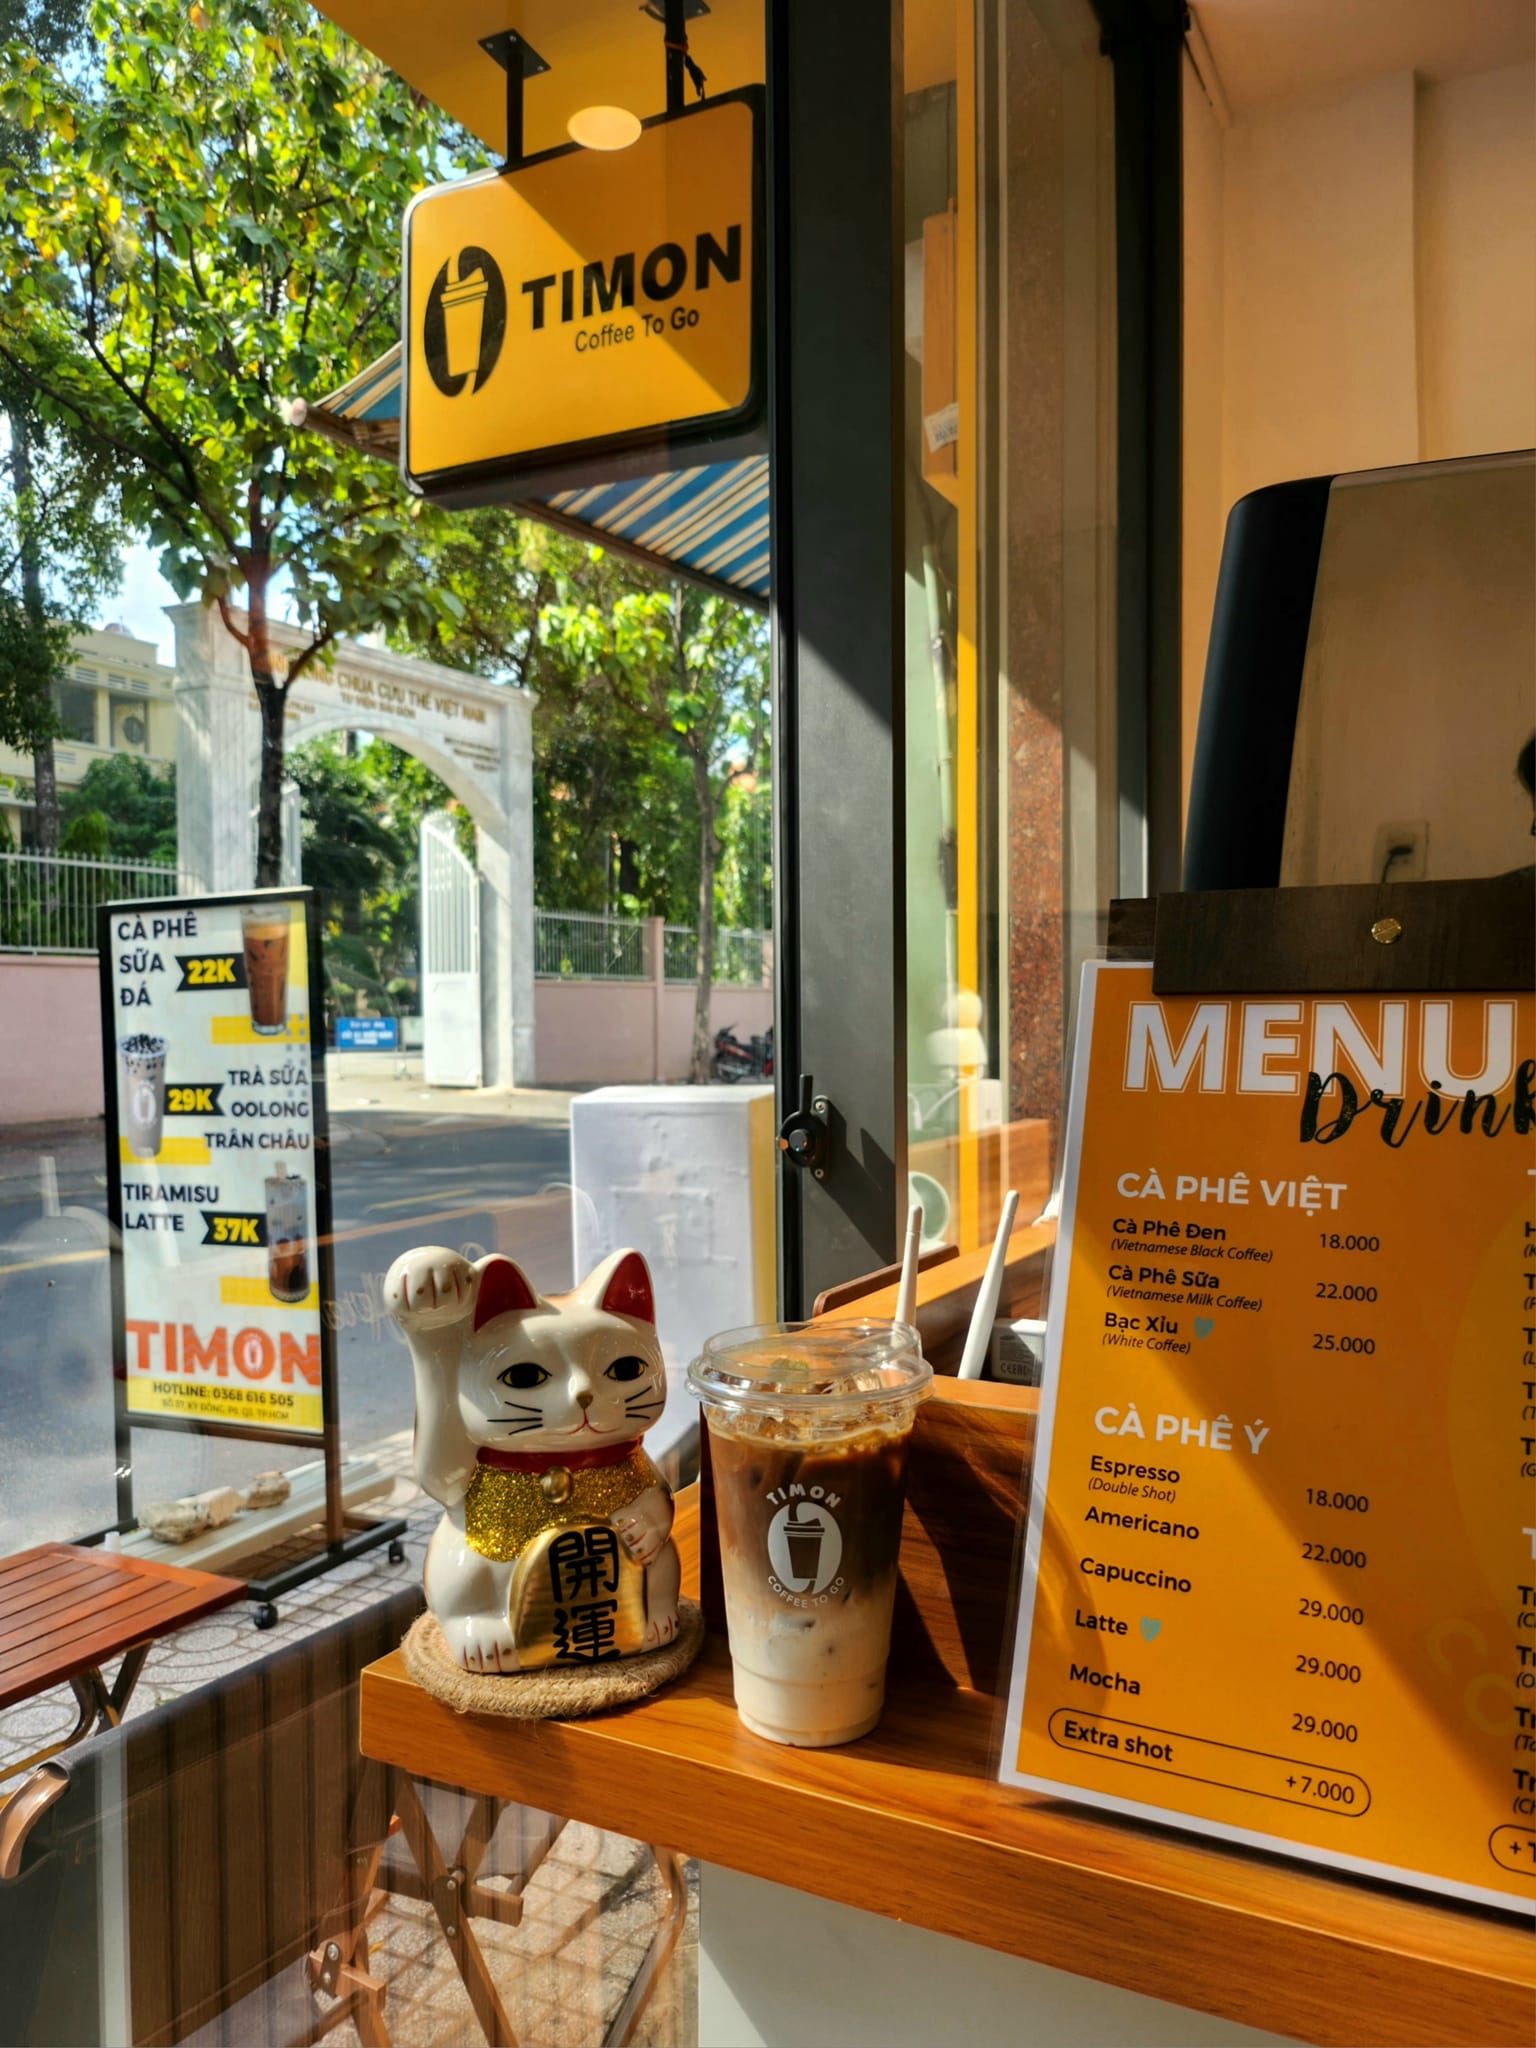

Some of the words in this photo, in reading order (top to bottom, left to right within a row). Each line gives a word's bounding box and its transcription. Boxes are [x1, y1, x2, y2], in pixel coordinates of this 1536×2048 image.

[521, 224, 742, 330] TIMON
[575, 322, 634, 353] Coffee
[641, 313, 665, 338] To
[670, 306, 700, 331] Go
[118, 914, 147, 940] CÀ
[153, 911, 198, 938] PHÊ
[120, 947, 165, 974] SỮA
[186, 957, 236, 985] 22K
[120, 983, 152, 1007] ĐÁ
[1122, 999, 1518, 1101] MENU
[228, 1064, 266, 1087] TRÀ
[270, 1062, 309, 1086] SỮA
[167, 1088, 214, 1113] 29K
[231, 1101, 310, 1118] OOLONG
[204, 1129, 254, 1150] TRÂN
[258, 1129, 310, 1150] CHÂU
[123, 1183, 220, 1204] TIRAMISU
[1117, 1168, 1166, 1200] CÀ
[1175, 1171, 1250, 1205] PHÊ
[1260, 1174, 1348, 1217] VIỆT
[124, 1213, 185, 1232] LATTE
[212, 1217, 260, 1245] 37K
[1112, 1217, 1137, 1235] Cà
[1143, 1219, 1180, 1238] Phê
[1186, 1222, 1226, 1241] Đen
[1110, 1237, 1188, 1256] (Vietnamese
[1190, 1242, 1224, 1259] Black
[1226, 1246, 1273, 1263] Coffee)
[1319, 1232, 1380, 1252] 18.000
[1108, 1264, 1133, 1282] Cà
[1138, 1266, 1177, 1285] Phê
[1182, 1270, 1220, 1290] Sữa
[1106, 1285, 1184, 1304] (Vietnamese
[1186, 1290, 1214, 1307] Milk
[1216, 1293, 1263, 1312] Coffee)
[1315, 1282, 1378, 1303] 22.000
[1104, 1311, 1141, 1334] Bạc
[1145, 1315, 1179, 1335] Xỉu
[125, 1318, 322, 1387] TIMON
[1101, 1332, 1144, 1349] (White
[1146, 1336, 1191, 1355] Coffee)
[1312, 1333, 1376, 1356] 25.000
[246, 1390, 266, 1405] 616
[269, 1393, 295, 1408] 505
[1094, 1402, 1146, 1440] CÀ
[1155, 1413, 1233, 1452] PHÊ
[1243, 1418, 1271, 1455] Ý
[1090, 1455, 1181, 1484] Espresso
[766, 1483, 843, 1509] TIMON
[1087, 1476, 1140, 1498] (Double
[1141, 1484, 1177, 1504] Shot)
[1305, 1487, 1370, 1513] 18.000
[1084, 1506, 1200, 1541] Americano
[1301, 1542, 1368, 1569] 22.000
[1079, 1557, 1192, 1594] Capuccino
[548, 1526, 621, 1663] 開運
[767, 1575, 808, 1609] COFFEE
[812, 1594, 829, 1608] TO
[829, 1576, 845, 1595] GO
[1075, 1609, 1129, 1637] Latte
[1298, 1598, 1364, 1626] 29.000
[1069, 1663, 1142, 1696] Mocha
[1295, 1654, 1362, 1685] 29.000
[1063, 1719, 1120, 1750] Extra
[1124, 1735, 1174, 1763] shot
[1291, 1713, 1358, 1744] 29.000
